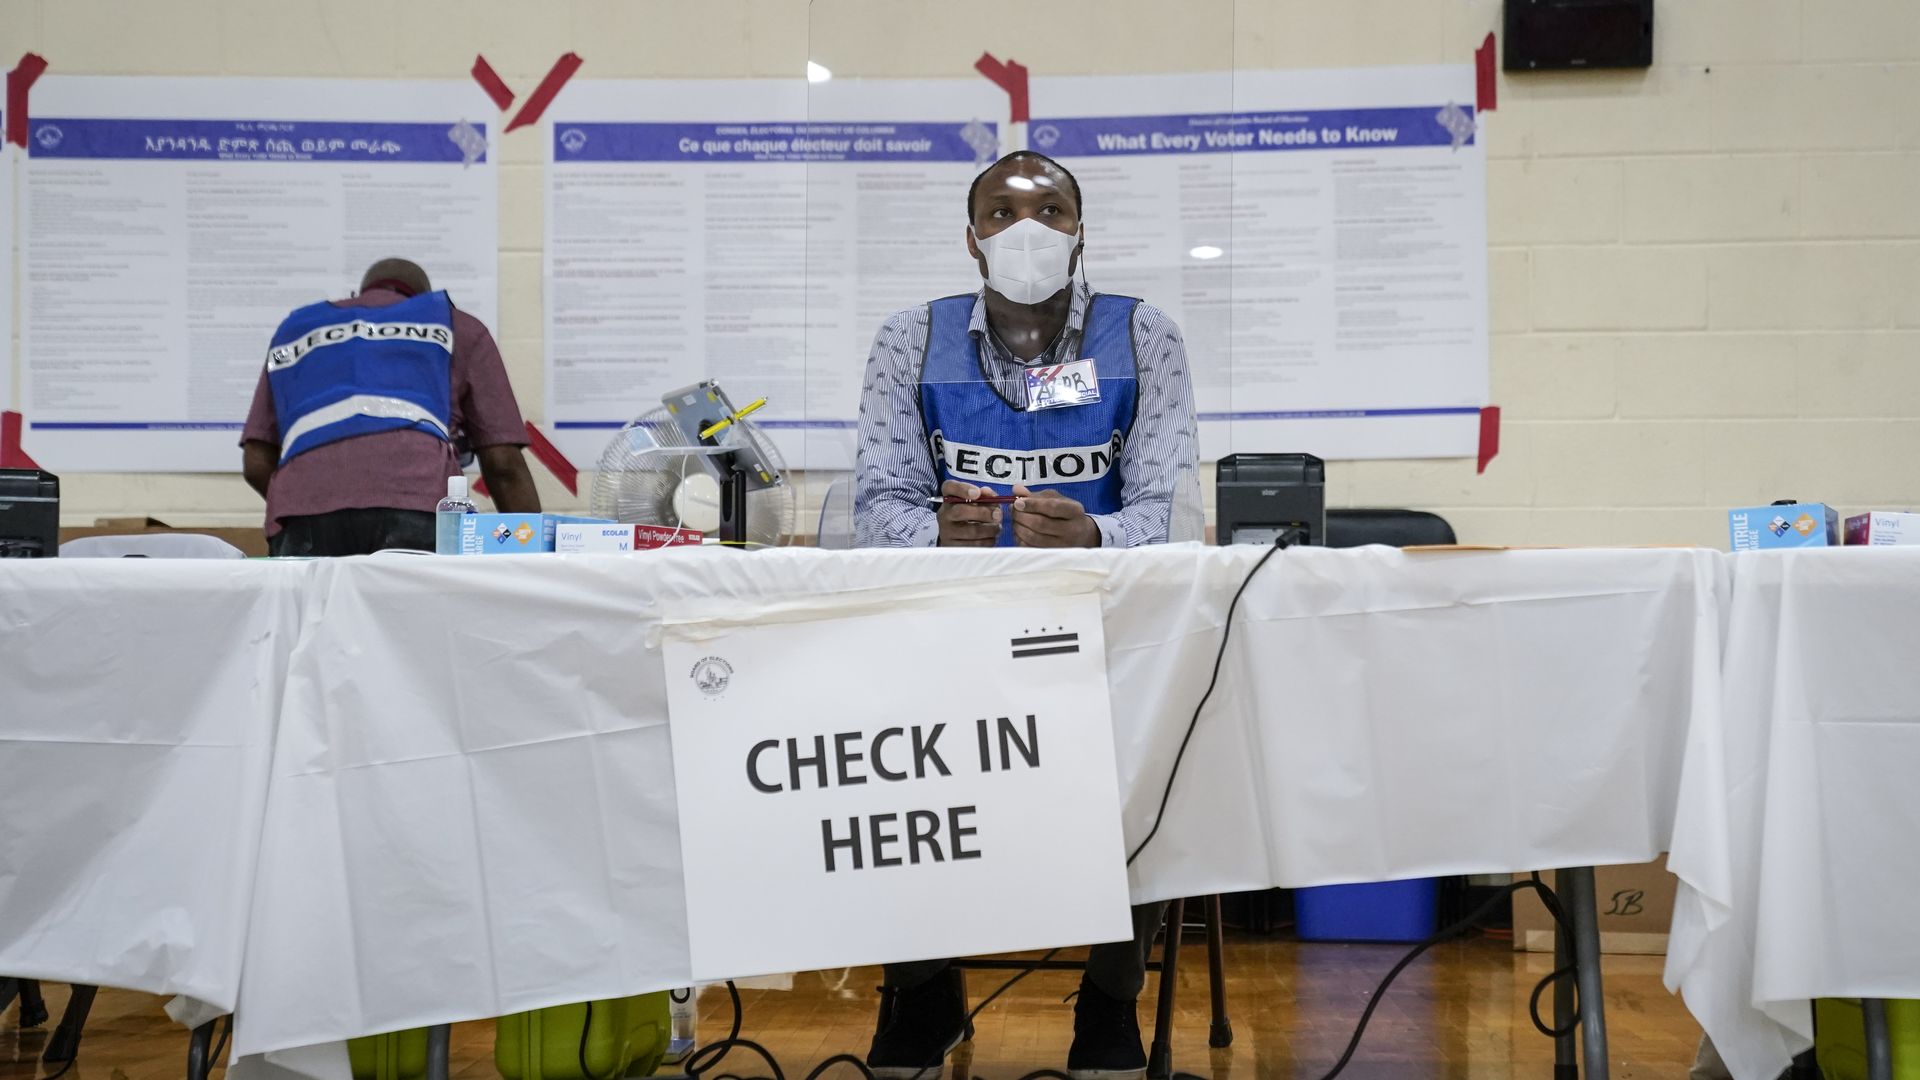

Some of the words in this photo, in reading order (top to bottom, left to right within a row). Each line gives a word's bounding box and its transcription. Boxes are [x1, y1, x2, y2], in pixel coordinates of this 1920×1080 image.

[679, 137, 699, 153] Ce
[702, 140, 730, 155] que
[734, 137, 788, 155] chaque
[790, 137, 850, 153] électeur
[853, 137, 883, 152] doit
[886, 137, 932, 152] savoir
[1097, 133, 1147, 150] What
[1150, 132, 1200, 151] Every
[1204, 130, 1254, 147] Voter
[1258, 129, 1318, 145] Needs
[1321, 127, 1341, 144] to
[1345, 126, 1398, 142] Know
[272, 322, 449, 366] ELECTIONS
[1733, 513, 1750, 551] ITRILE
[1874, 518, 1900, 529] Vinyl
[463, 517, 477, 555] ITRILE
[561, 532, 582, 542] Vinyl
[619, 542, 628, 551] M
[638, 529, 652, 543] Vinyl
[1749, 529, 1761, 550] ARGE
[745, 722, 953, 794] CHECK
[976, 714, 1041, 773] IN
[821, 805, 982, 873] HERE
